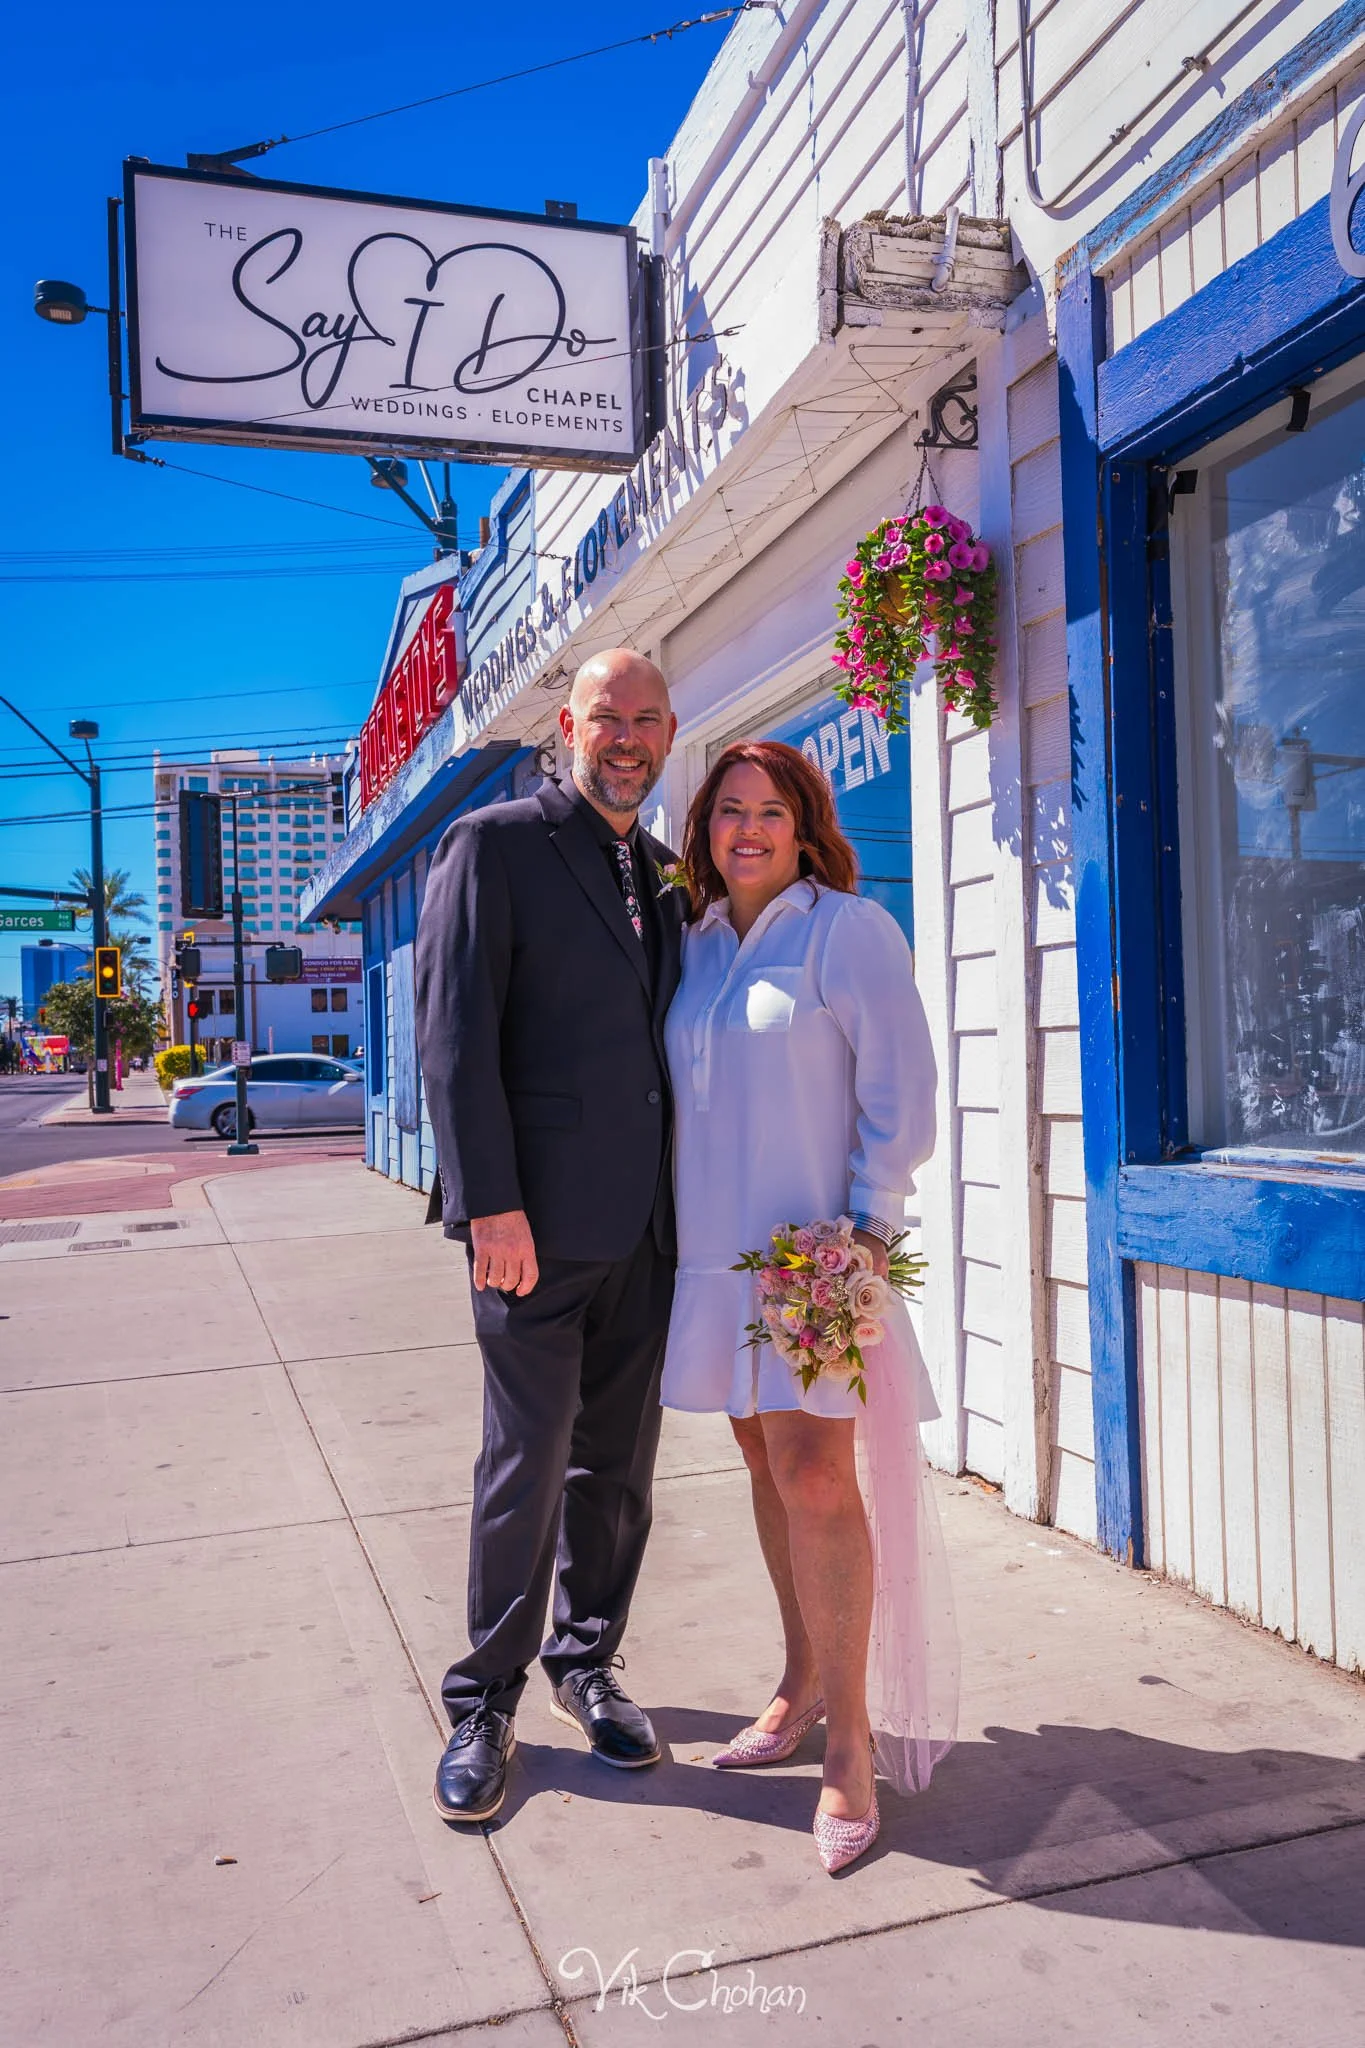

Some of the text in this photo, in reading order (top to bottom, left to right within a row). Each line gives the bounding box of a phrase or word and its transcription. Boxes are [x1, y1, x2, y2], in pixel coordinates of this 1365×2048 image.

[204, 222, 248, 242] THE
[155, 227, 616, 409] Say I Do
[351, 396, 623, 433] WEDDINGS ELOPEMENTS
[526, 387, 622, 411] CHAPEL
[459, 605, 537, 725] WEDDINGS
[562, 352, 727, 612] ELOPEMENTS
[402, 588, 452, 754] TOYS
